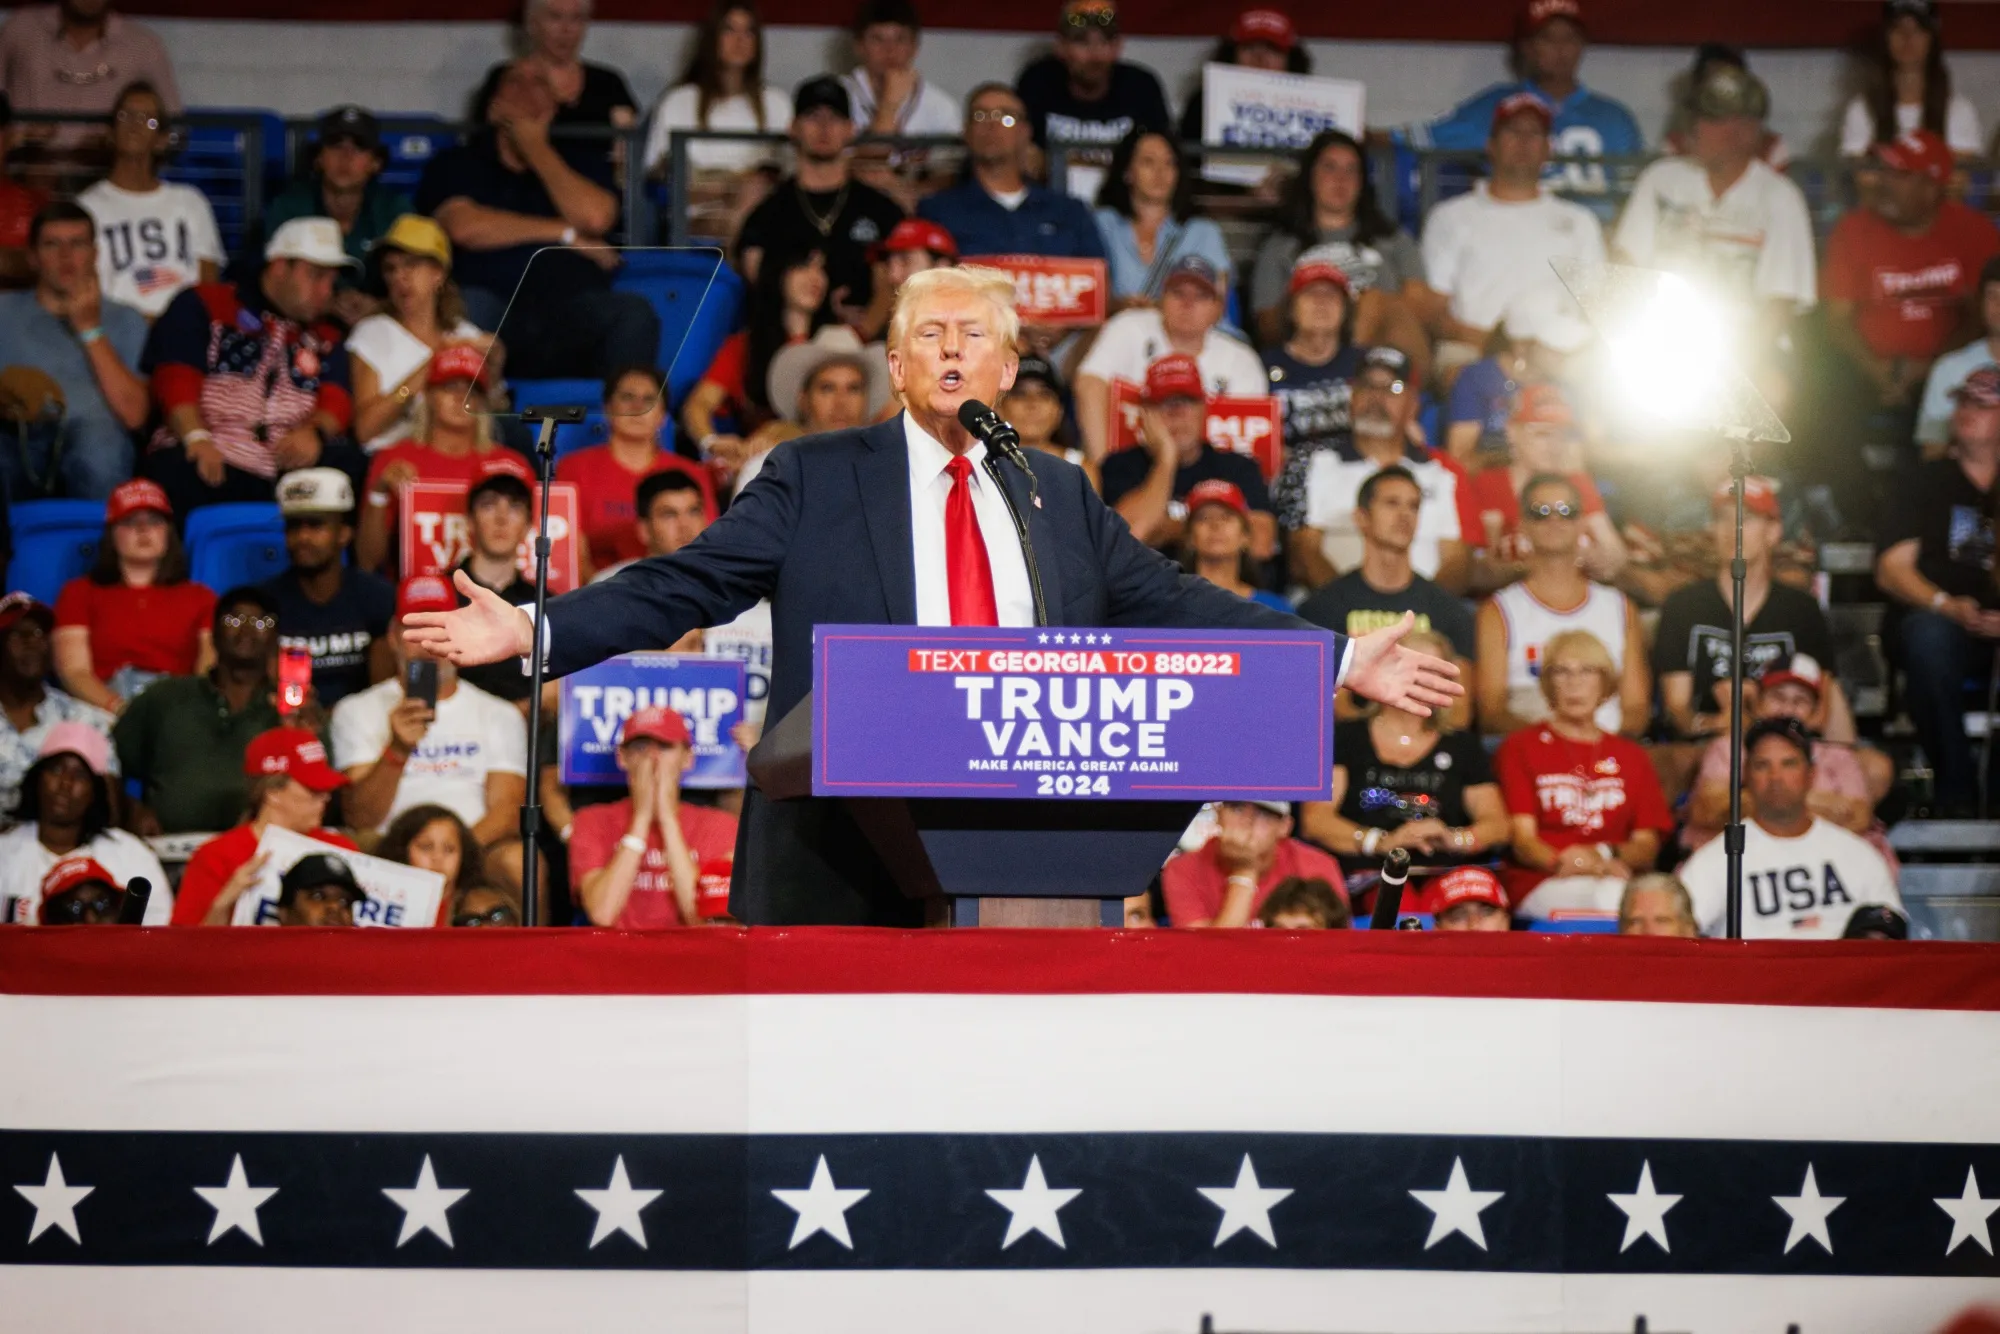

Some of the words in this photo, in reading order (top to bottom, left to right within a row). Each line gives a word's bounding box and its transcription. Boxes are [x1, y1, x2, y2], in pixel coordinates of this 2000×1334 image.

[916, 651, 981, 671] TEXT
[988, 652, 1106, 673] GEORGIA
[1113, 653, 1147, 673] TO
[1154, 654, 1232, 674] 88022
[573, 686, 738, 719] TRUMP
[955, 677, 1194, 721] TRUMP
[982, 722, 1166, 758] VANCE
[969, 760, 1008, 771] MAKE
[1013, 760, 1075, 772] AMERICA
[1080, 761, 1125, 772] GREAT
[1130, 761, 1179, 773] AGAIN!
[1037, 775, 1110, 796] 2024
[1749, 863, 1852, 915] USA
